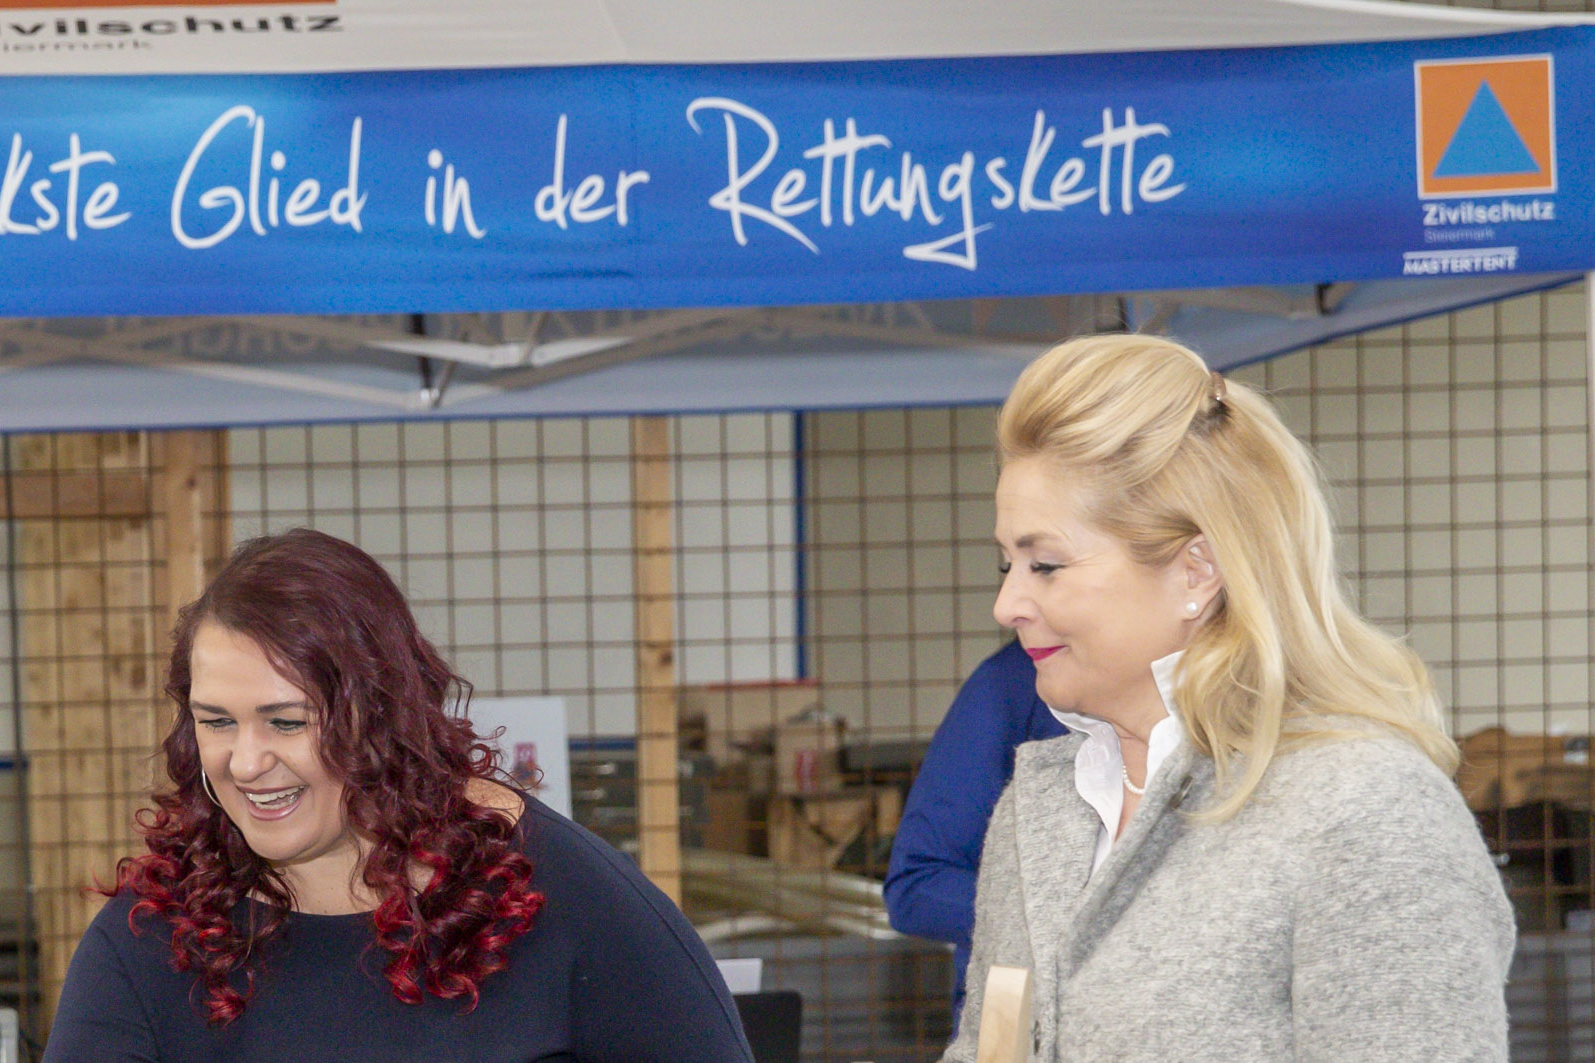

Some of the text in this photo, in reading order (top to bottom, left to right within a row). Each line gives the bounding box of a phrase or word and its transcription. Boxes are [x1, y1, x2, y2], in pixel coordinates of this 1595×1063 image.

[170, 104, 368, 250] Glied
[424, 148, 487, 240] in
[534, 113, 651, 230] der
[685, 97, 1186, 271] Rettungskette
[1422, 200, 1555, 226] Zivilschutz
[1403, 255, 1517, 275] MASTERTENT
